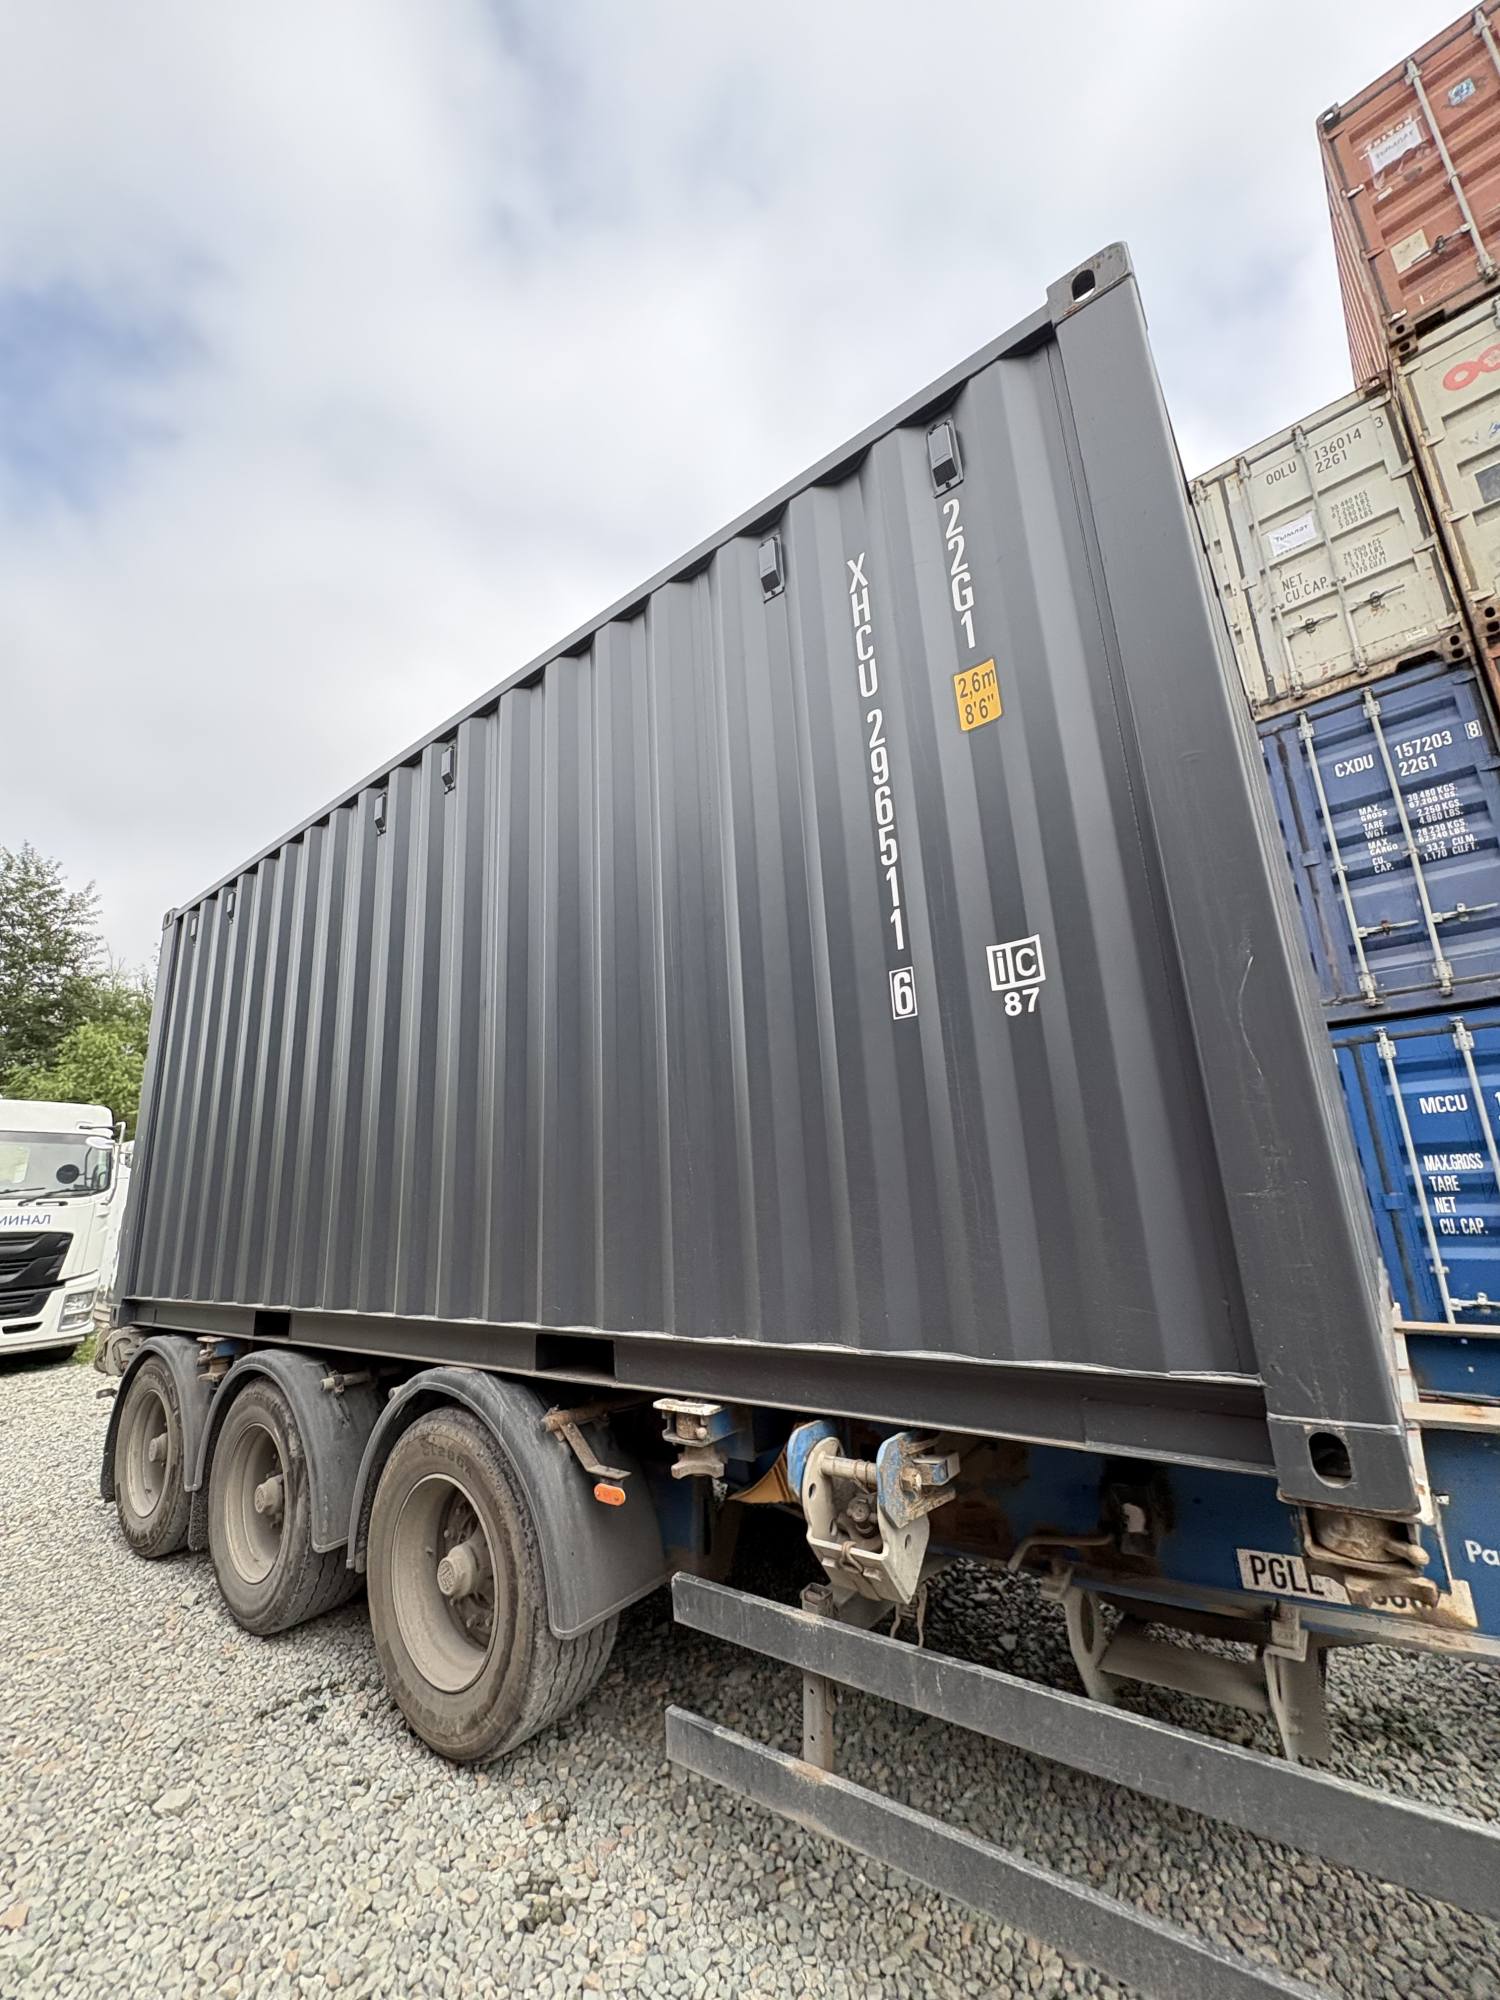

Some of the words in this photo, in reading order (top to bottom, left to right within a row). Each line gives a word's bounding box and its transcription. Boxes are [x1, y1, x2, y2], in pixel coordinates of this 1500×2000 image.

[1266, 461, 1297, 486] OOLU
[1314, 428, 1362, 461] 136014
[1374, 416, 1384, 429] 3
[1315, 450, 1348, 474] 22G1
[943, 498, 976, 649] 22G1
[957, 667, 996, 700] 2,6m
[1334, 754, 1374, 777] CXDU
[1394, 730, 1453, 759] 157203
[1468, 722, 1479, 737] 8
[1399, 753, 1437, 777] 22G1
[846, 552, 878, 698] XHCU
[866, 708, 905, 951] 296511
[892, 970, 913, 1016] 6
[1360, 809, 1388, 821] GROSS
[1444, 807, 1464, 819] LBS.
[1363, 820, 1384, 831] TARE
[1364, 827, 1388, 839] WGT.
[1370, 843, 1398, 856] CARGO
[1374, 862, 1394, 874] CAP.
[1004, 987, 1040, 1016] 87
[1419, 1093, 1468, 1114] MCCU
[1429, 1175, 1461, 1192] TARE
[1433, 1196, 1457, 1214] NET
